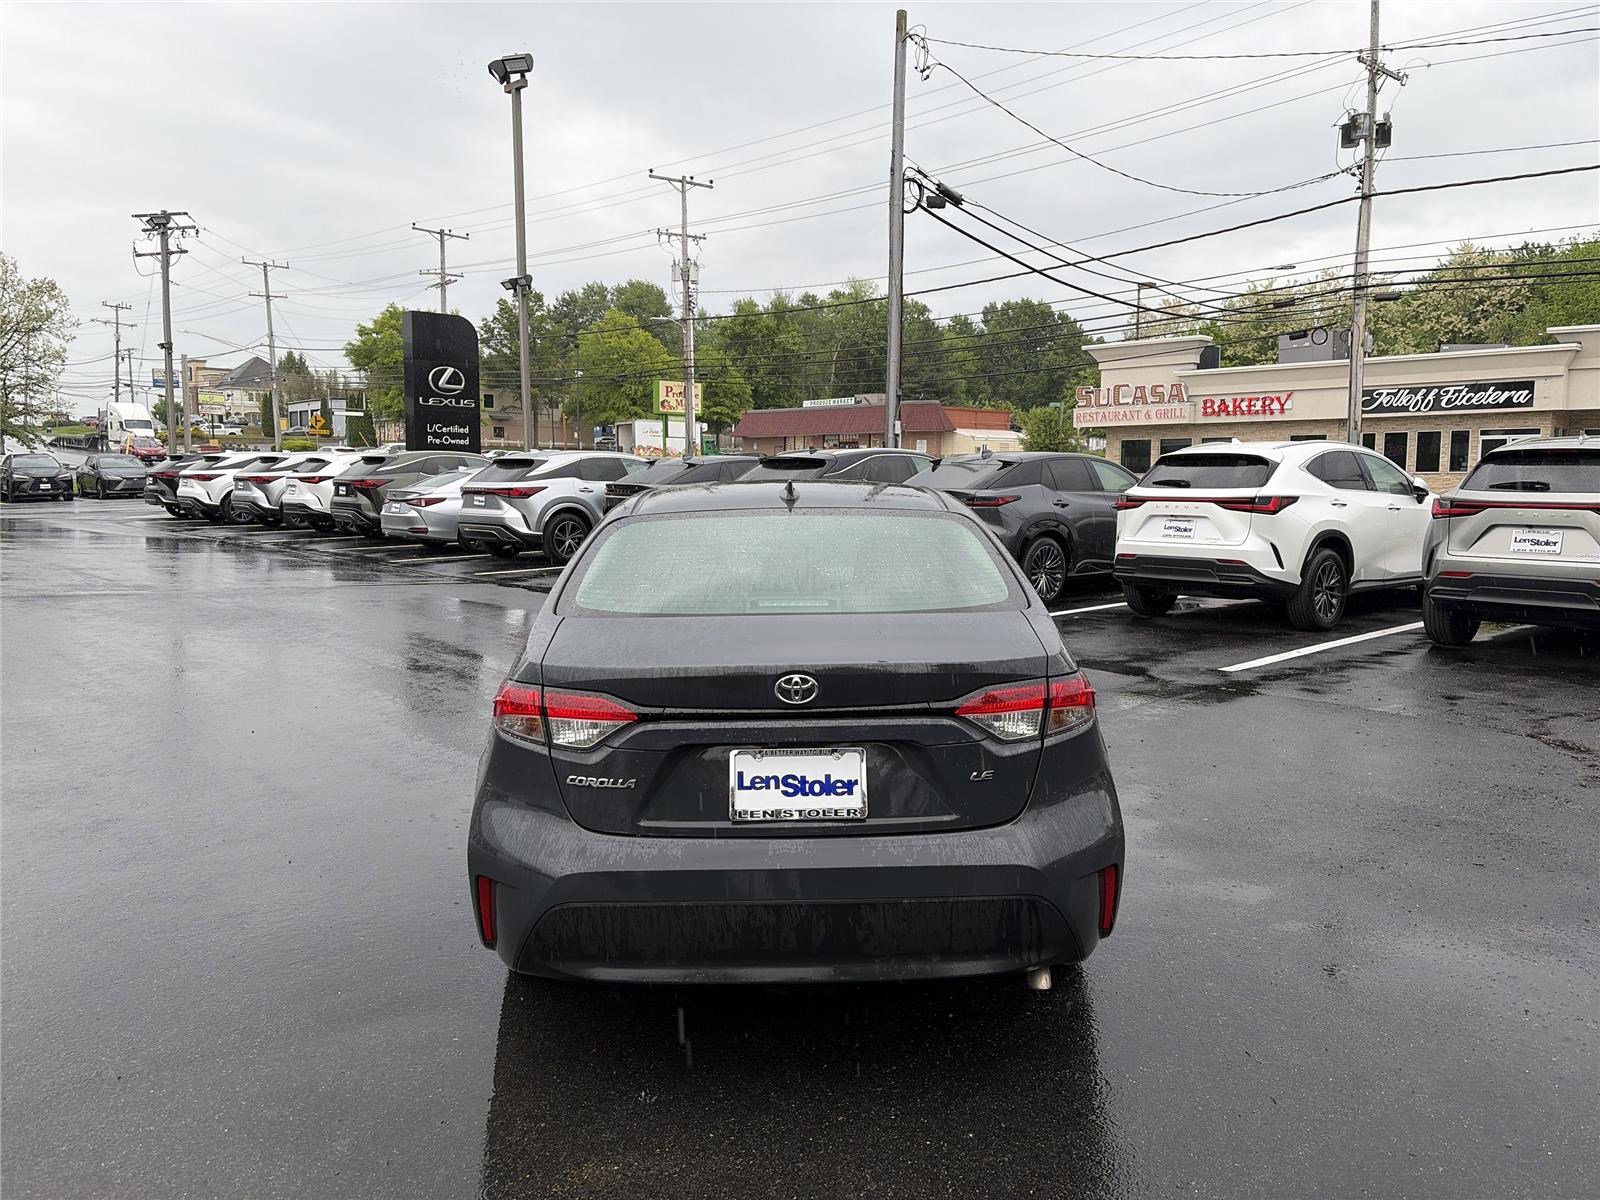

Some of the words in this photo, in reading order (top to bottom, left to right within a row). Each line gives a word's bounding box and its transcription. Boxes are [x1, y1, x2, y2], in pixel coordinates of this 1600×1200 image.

[664, 385, 700, 399] Prode
[1439, 385, 1532, 408] Etcetera
[419, 396, 476, 408] LEXUS
[1202, 391, 1293, 416] BAKERY
[1076, 409, 1141, 424] RESTAURANT
[1144, 410, 1152, 420] &
[1155, 407, 1185, 420] GRILL
[427, 423, 469, 433] L/Certified
[427, 435, 469, 445] Pre-Owned
[566, 775, 637, 789] COROLLA
[969, 770, 995, 781] LE
[737, 810, 775, 819] LEN
[782, 808, 860, 818] STOLER
